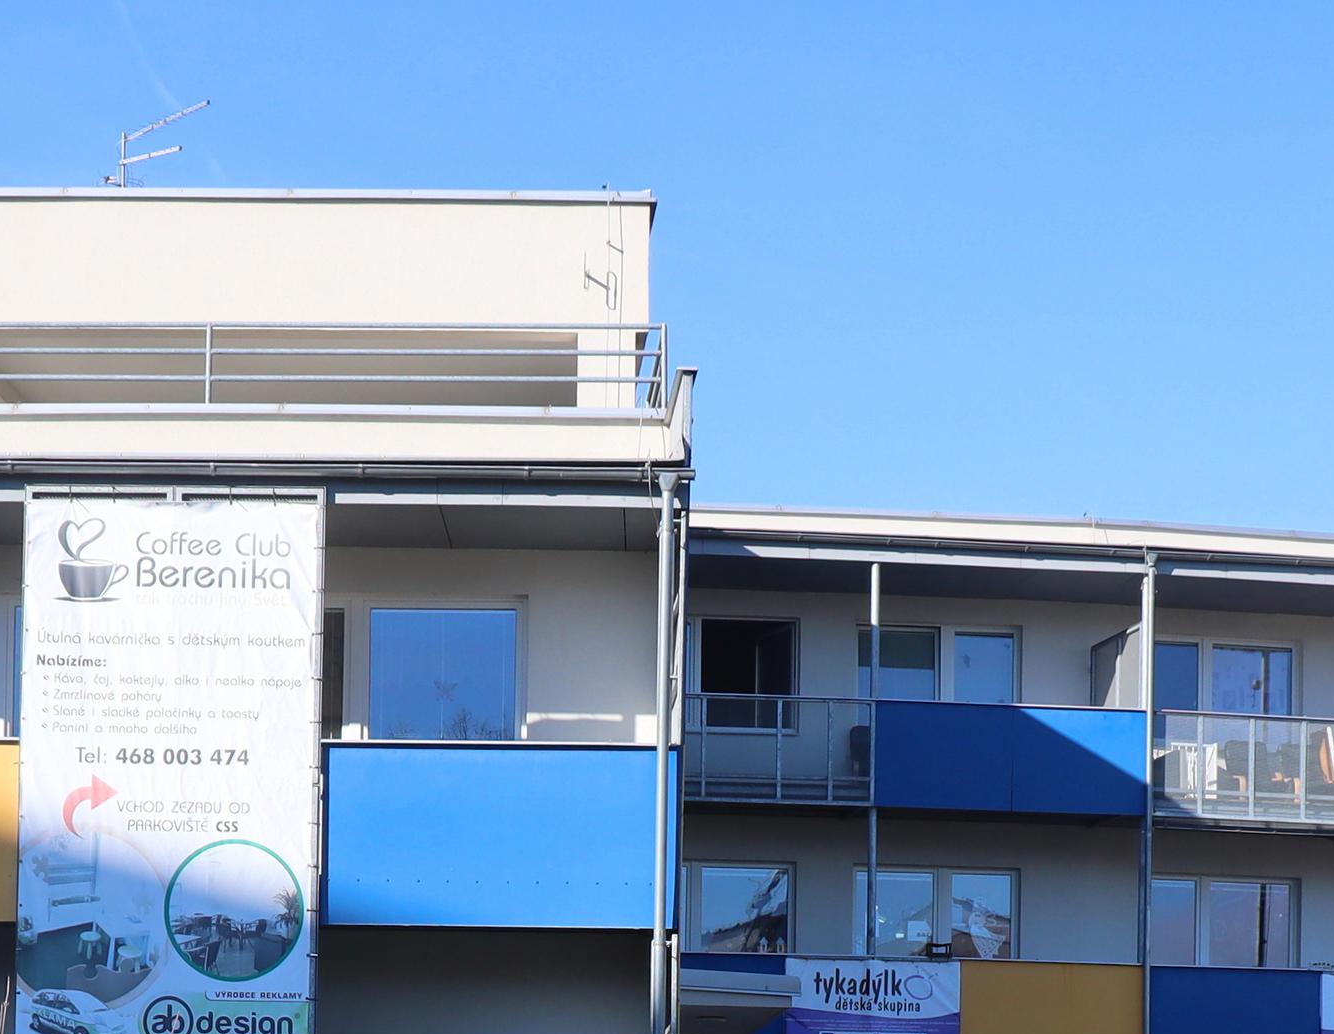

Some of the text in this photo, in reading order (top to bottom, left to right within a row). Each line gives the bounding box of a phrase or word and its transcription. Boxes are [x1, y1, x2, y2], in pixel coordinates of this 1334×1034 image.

[136, 532, 291, 557] Coffee Club
[136, 557, 291, 589] Berenika
[37, 628, 305, 648] Útulná kavárnička s dětským koutkem
[37, 655, 106, 667] Nabízíme:
[54, 673, 86, 685] Káva,
[175, 675, 199, 685] alko
[216, 676, 254, 686] nealko
[261, 676, 301, 688] nápoje
[53, 689, 114, 700] Zmrzlinové
[53, 705, 85, 716] Slané
[102, 706, 140, 717] sladké
[146, 707, 201, 720] palačinky
[53, 722, 197, 735] Panini a mnoho dalšího
[75, 747, 249, 765] Tel: 468 003 474
[117, 801, 250, 814] VCHOD ZEZADU OD
[128, 817, 238, 832] PARKOVIŠTĚ CSS
[261, 991, 302, 1000] REKLAMY
[836, 996, 920, 1015] dětská skupina
[152, 1004, 184, 1034] ab
